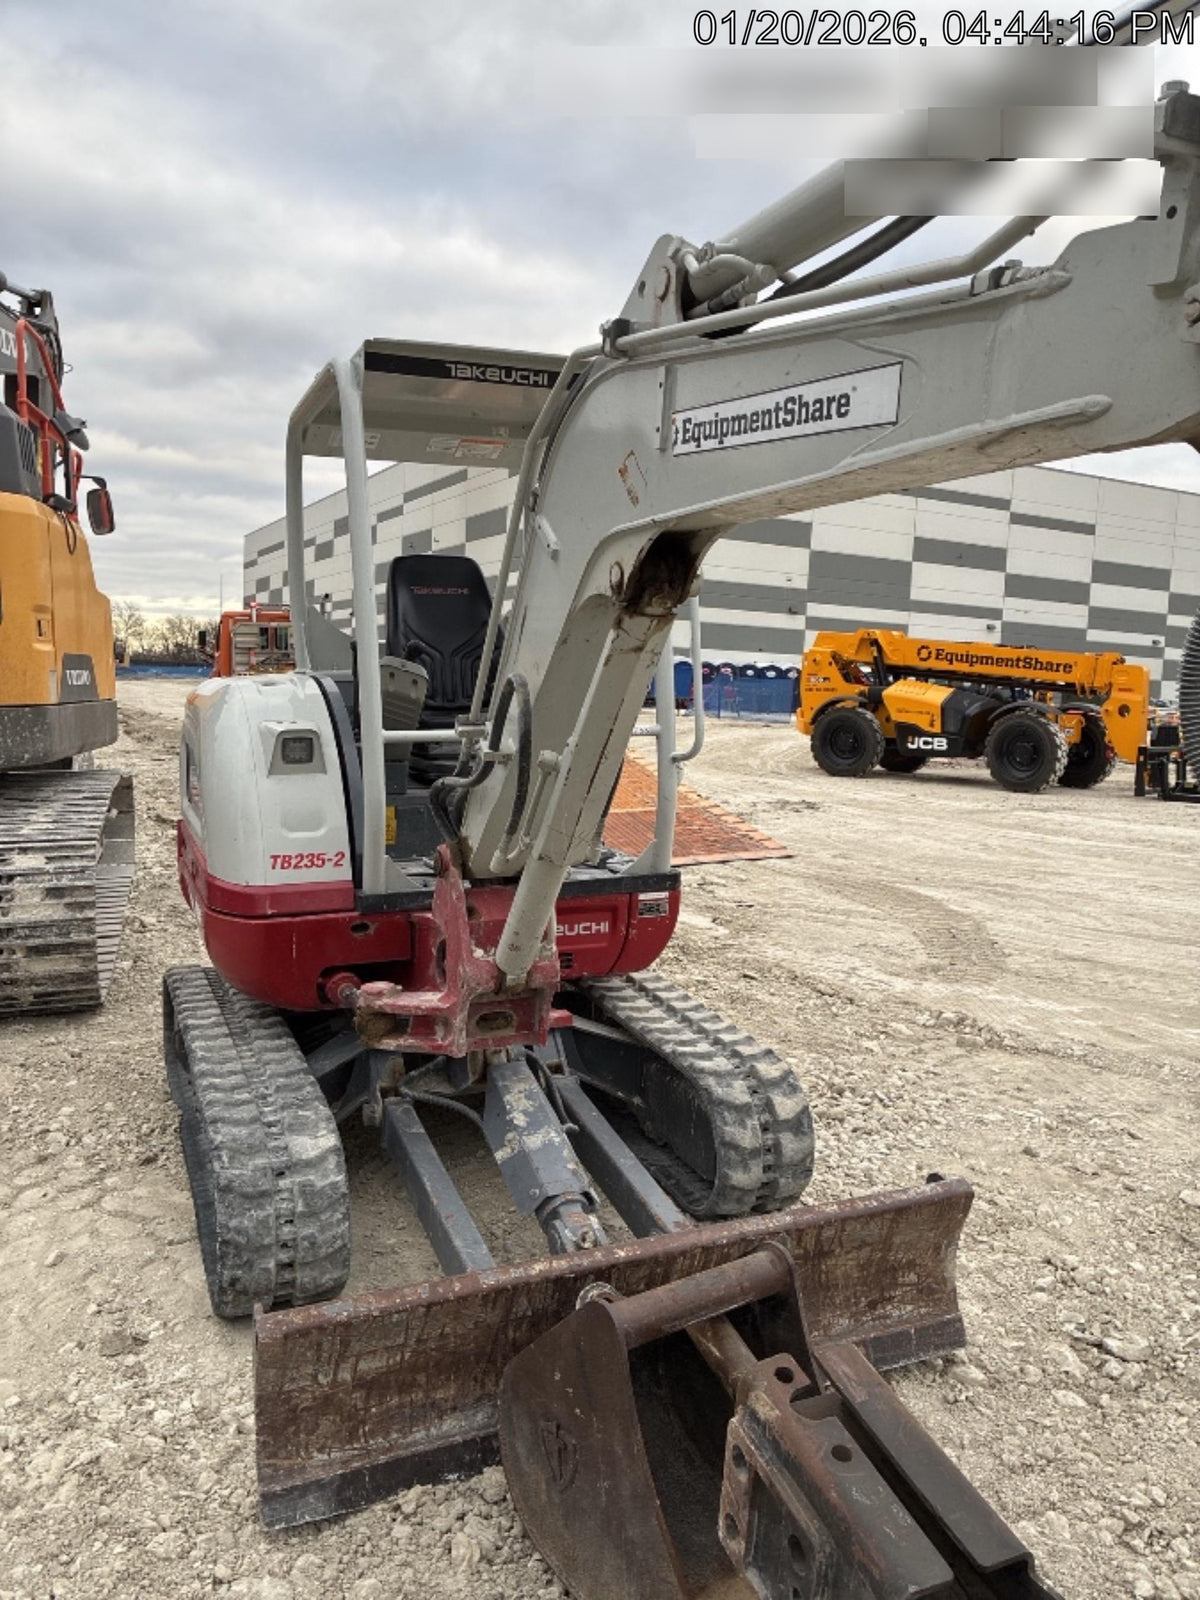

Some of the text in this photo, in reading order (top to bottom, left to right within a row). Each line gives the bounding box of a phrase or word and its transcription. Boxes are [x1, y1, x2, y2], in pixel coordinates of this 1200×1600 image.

[681, 392, 851, 448] EquipmentShare
[935, 649, 1073, 674] EquipmentShare
[907, 736, 948, 751] JCB
[270, 852, 346, 870] TB235-2
